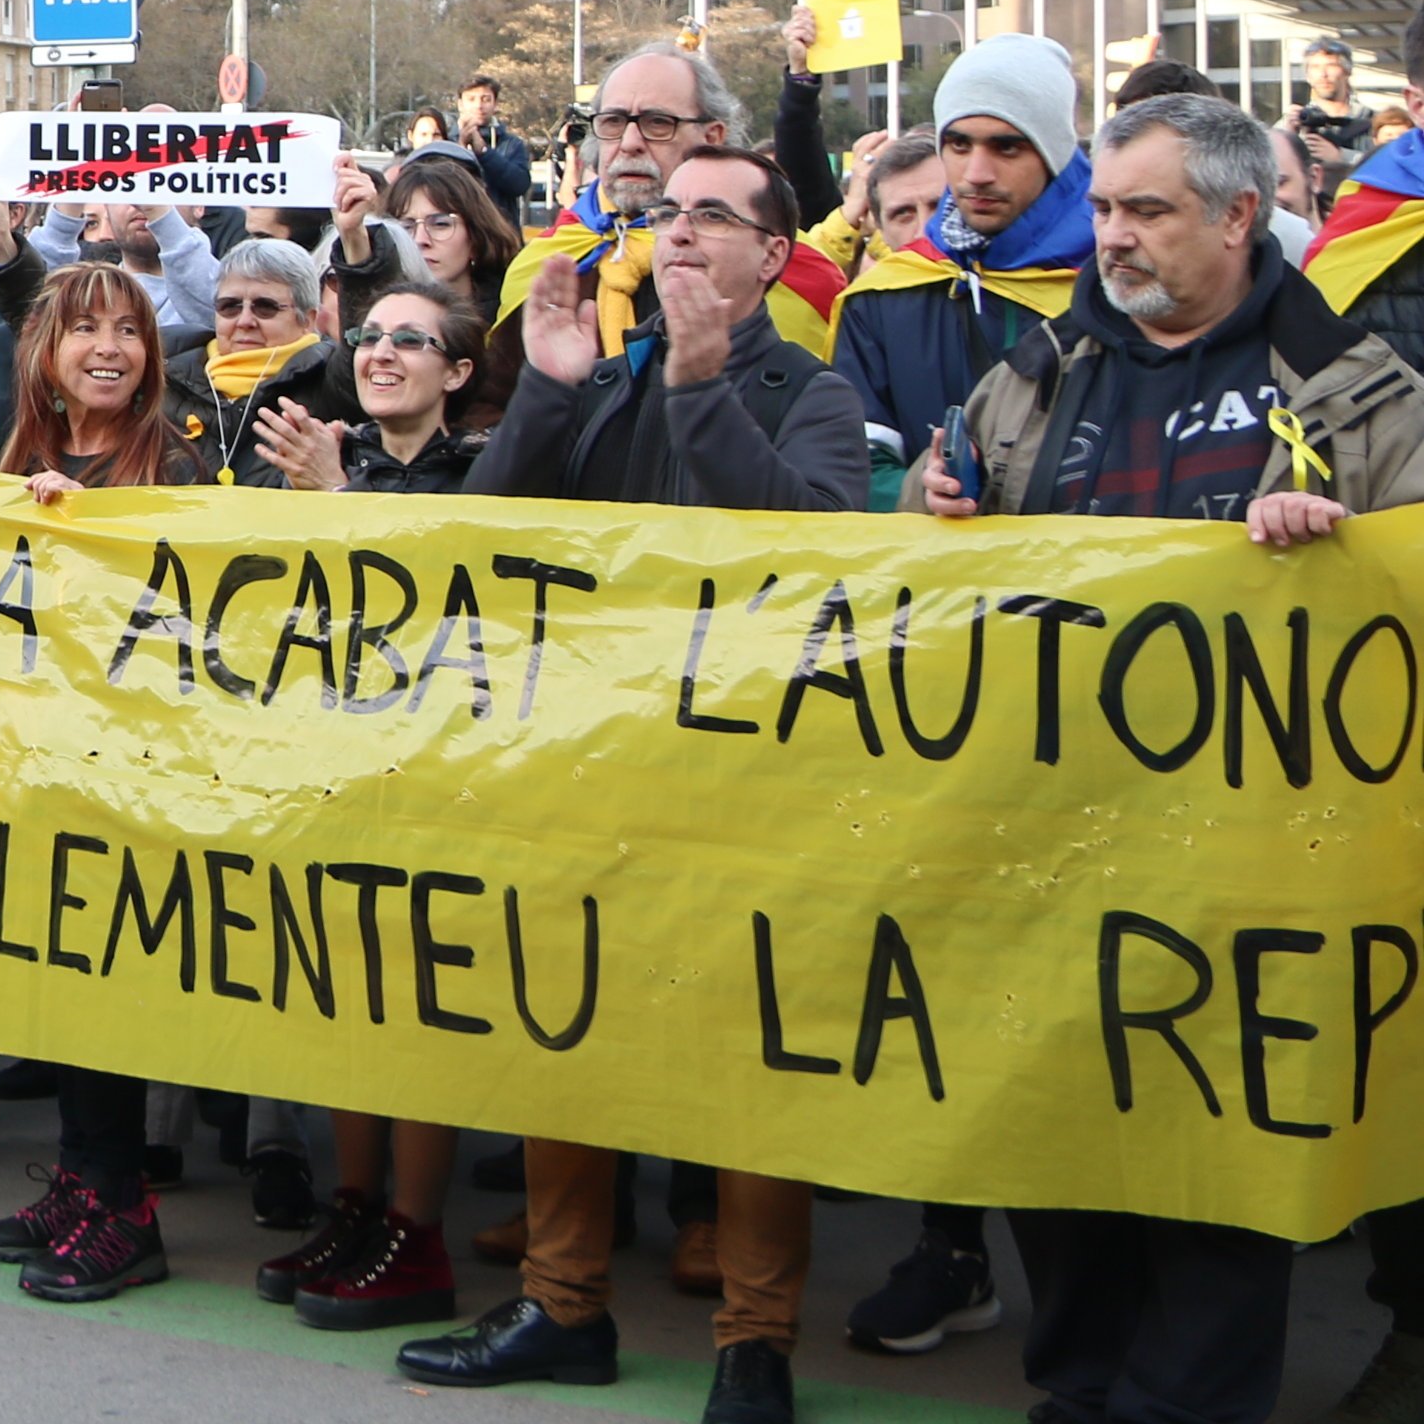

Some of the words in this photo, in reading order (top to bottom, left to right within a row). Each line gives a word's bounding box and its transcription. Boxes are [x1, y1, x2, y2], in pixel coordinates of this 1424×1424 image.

[28, 169, 136, 192] PRESOS
[148, 166, 288, 194] POLÍTICS!
[29, 122, 289, 164] LLIBERTAT
[107, 537, 599, 722] ACABAT
[675, 572, 1424, 790] L'AUTONO
[752, 910, 946, 1103] LA
[1096, 909, 1424, 1139] REP
